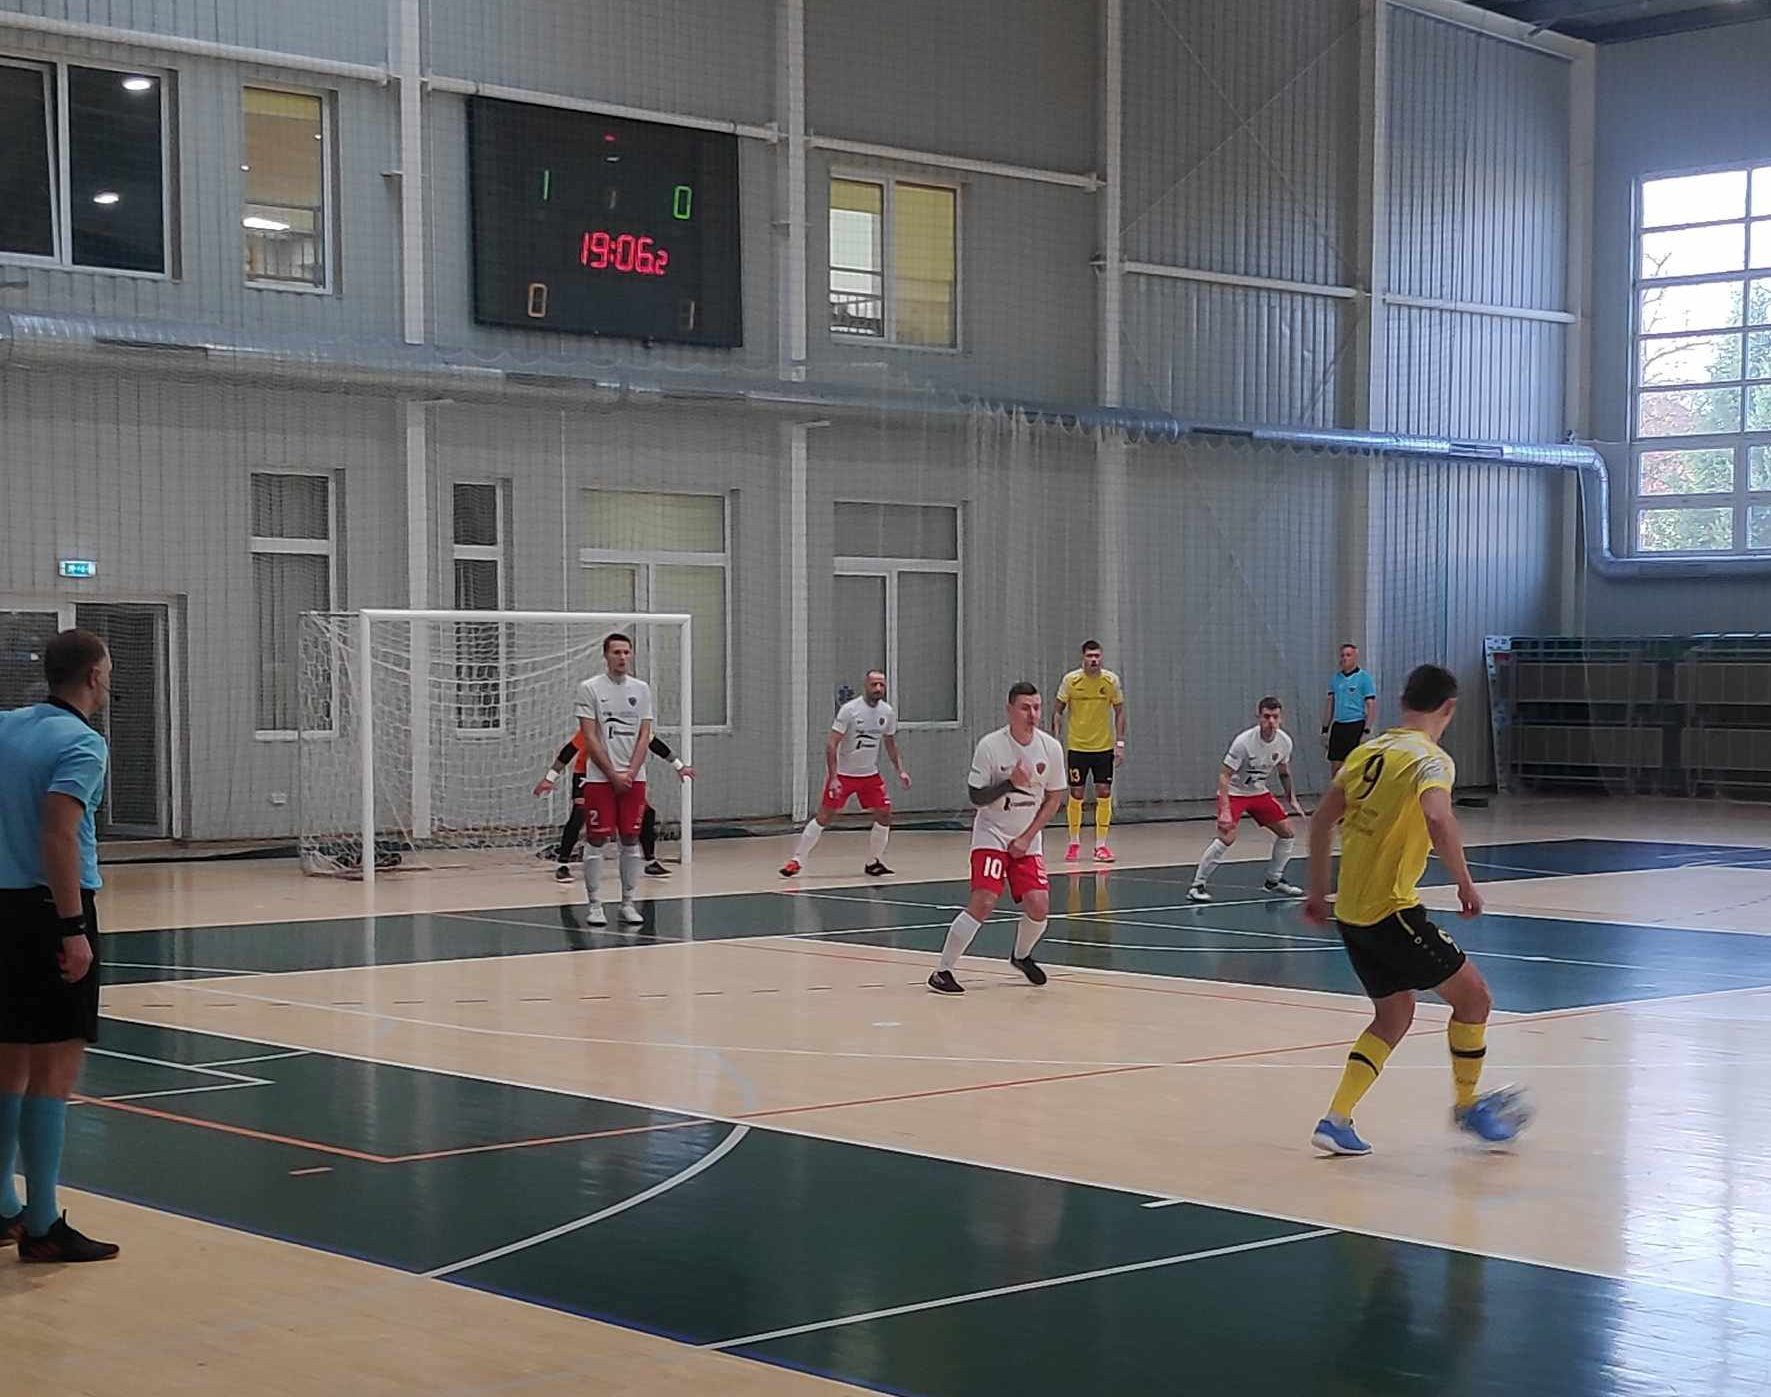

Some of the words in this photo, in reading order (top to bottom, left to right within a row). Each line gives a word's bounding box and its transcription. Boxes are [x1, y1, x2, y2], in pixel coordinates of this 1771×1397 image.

[672, 185, 692, 220] 0
[528, 283, 548, 317] 0
[1069, 768, 1080, 782] 13
[1357, 752, 1385, 800] 9
[589, 809, 599, 826] 2
[983, 856, 1003, 880] 10
